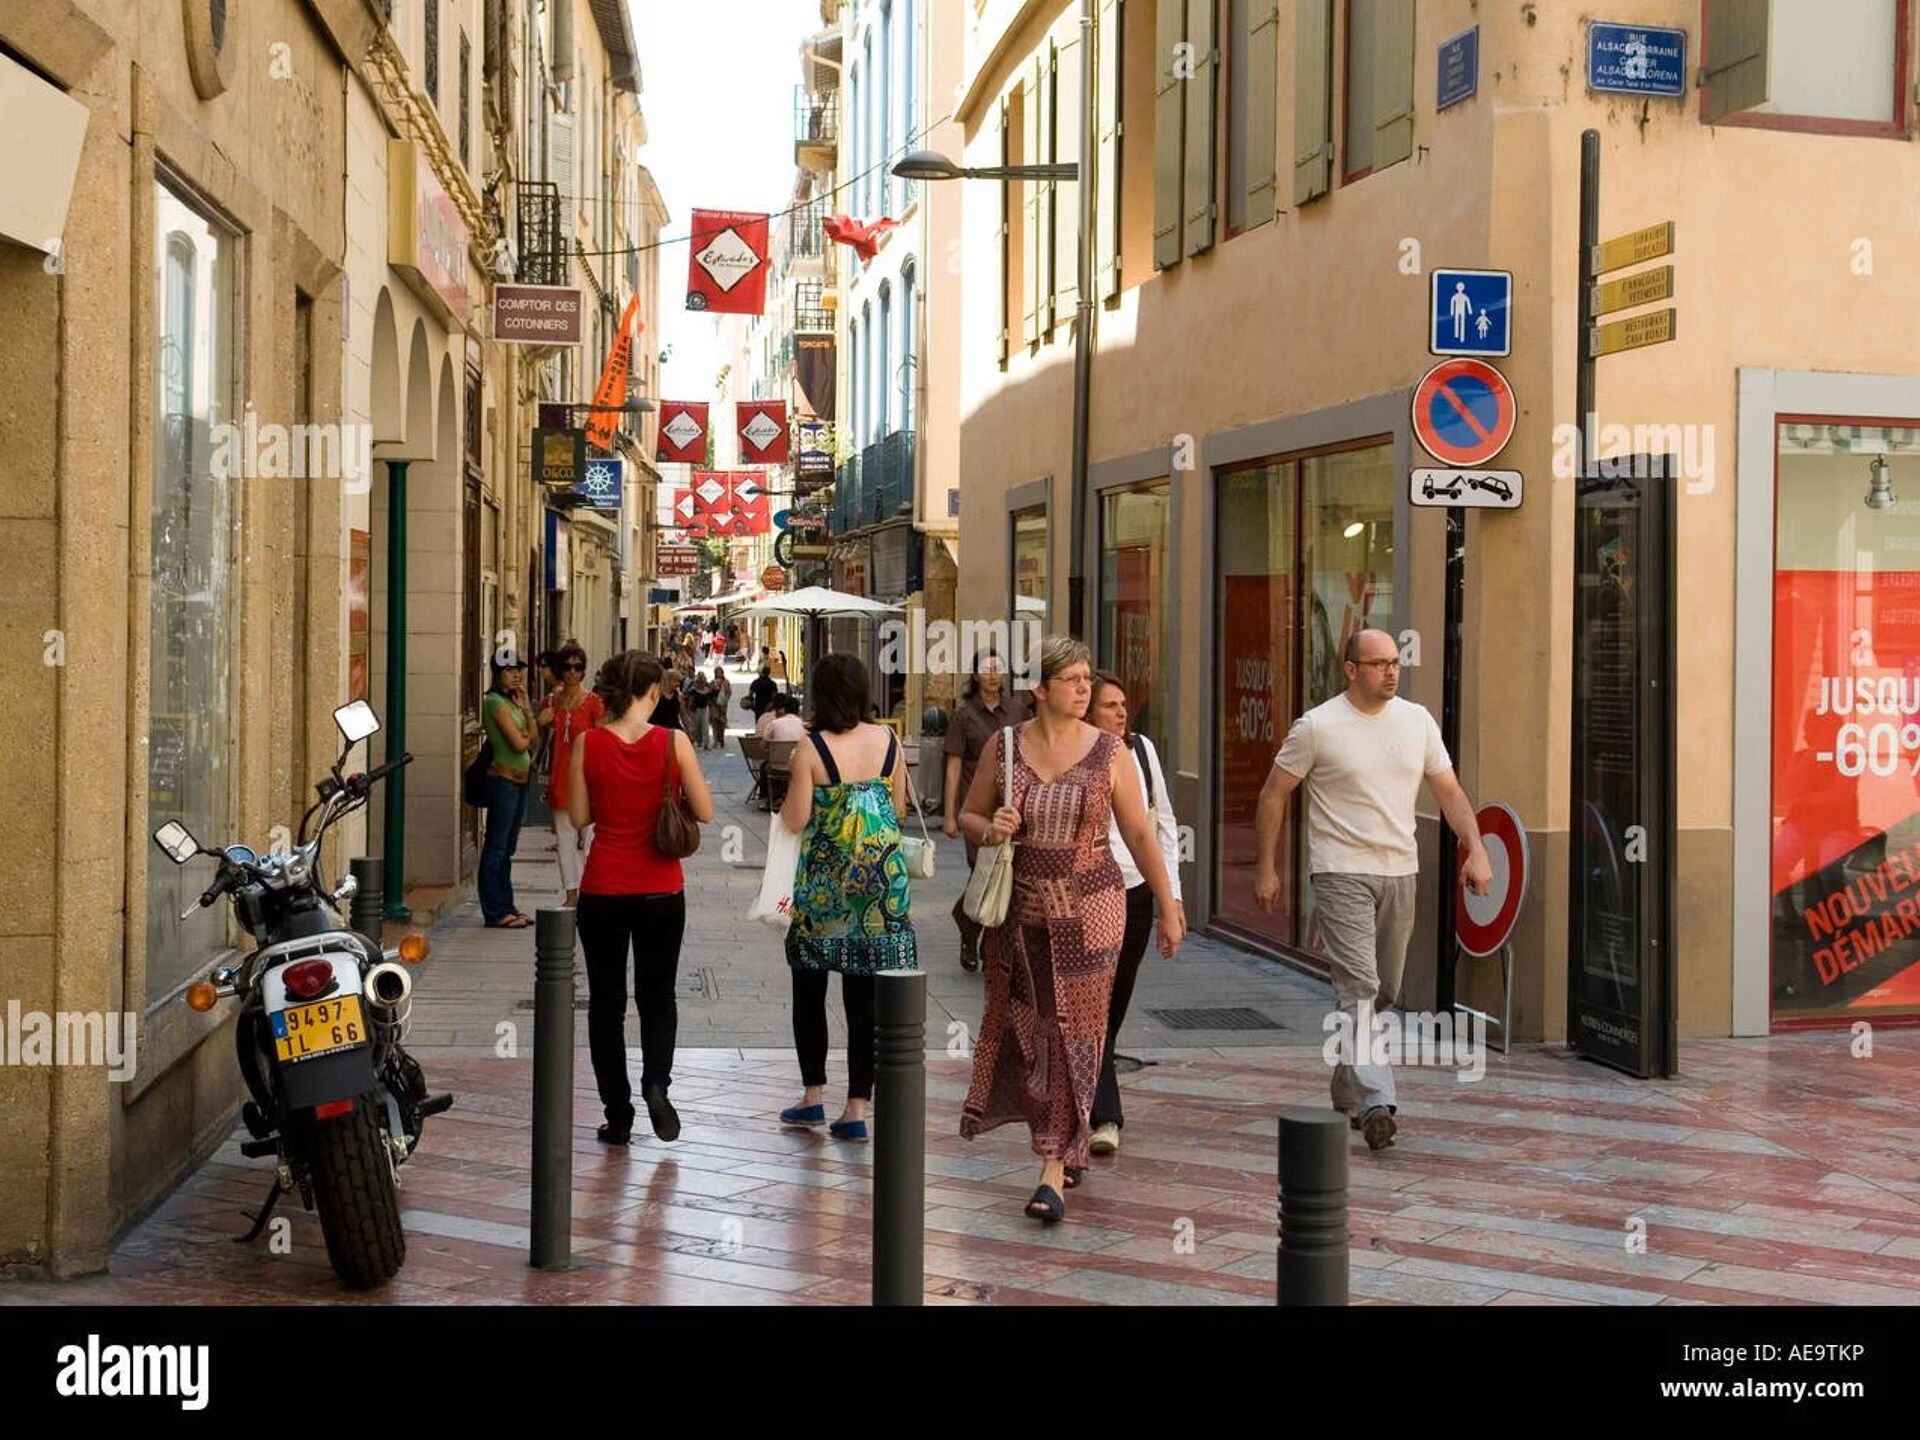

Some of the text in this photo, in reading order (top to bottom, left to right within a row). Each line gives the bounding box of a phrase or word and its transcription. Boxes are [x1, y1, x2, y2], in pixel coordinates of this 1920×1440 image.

[498, 299, 577, 313] COMPTOIR DES
[504, 317, 569, 331] COTONNIERS
[1803, 843, 1920, 941] NOUVEL
[1812, 888, 1920, 986] DÉMAR
[288, 1002, 342, 1031] 9497
[283, 1034, 310, 1057] TL
[331, 1022, 358, 1045] 66
